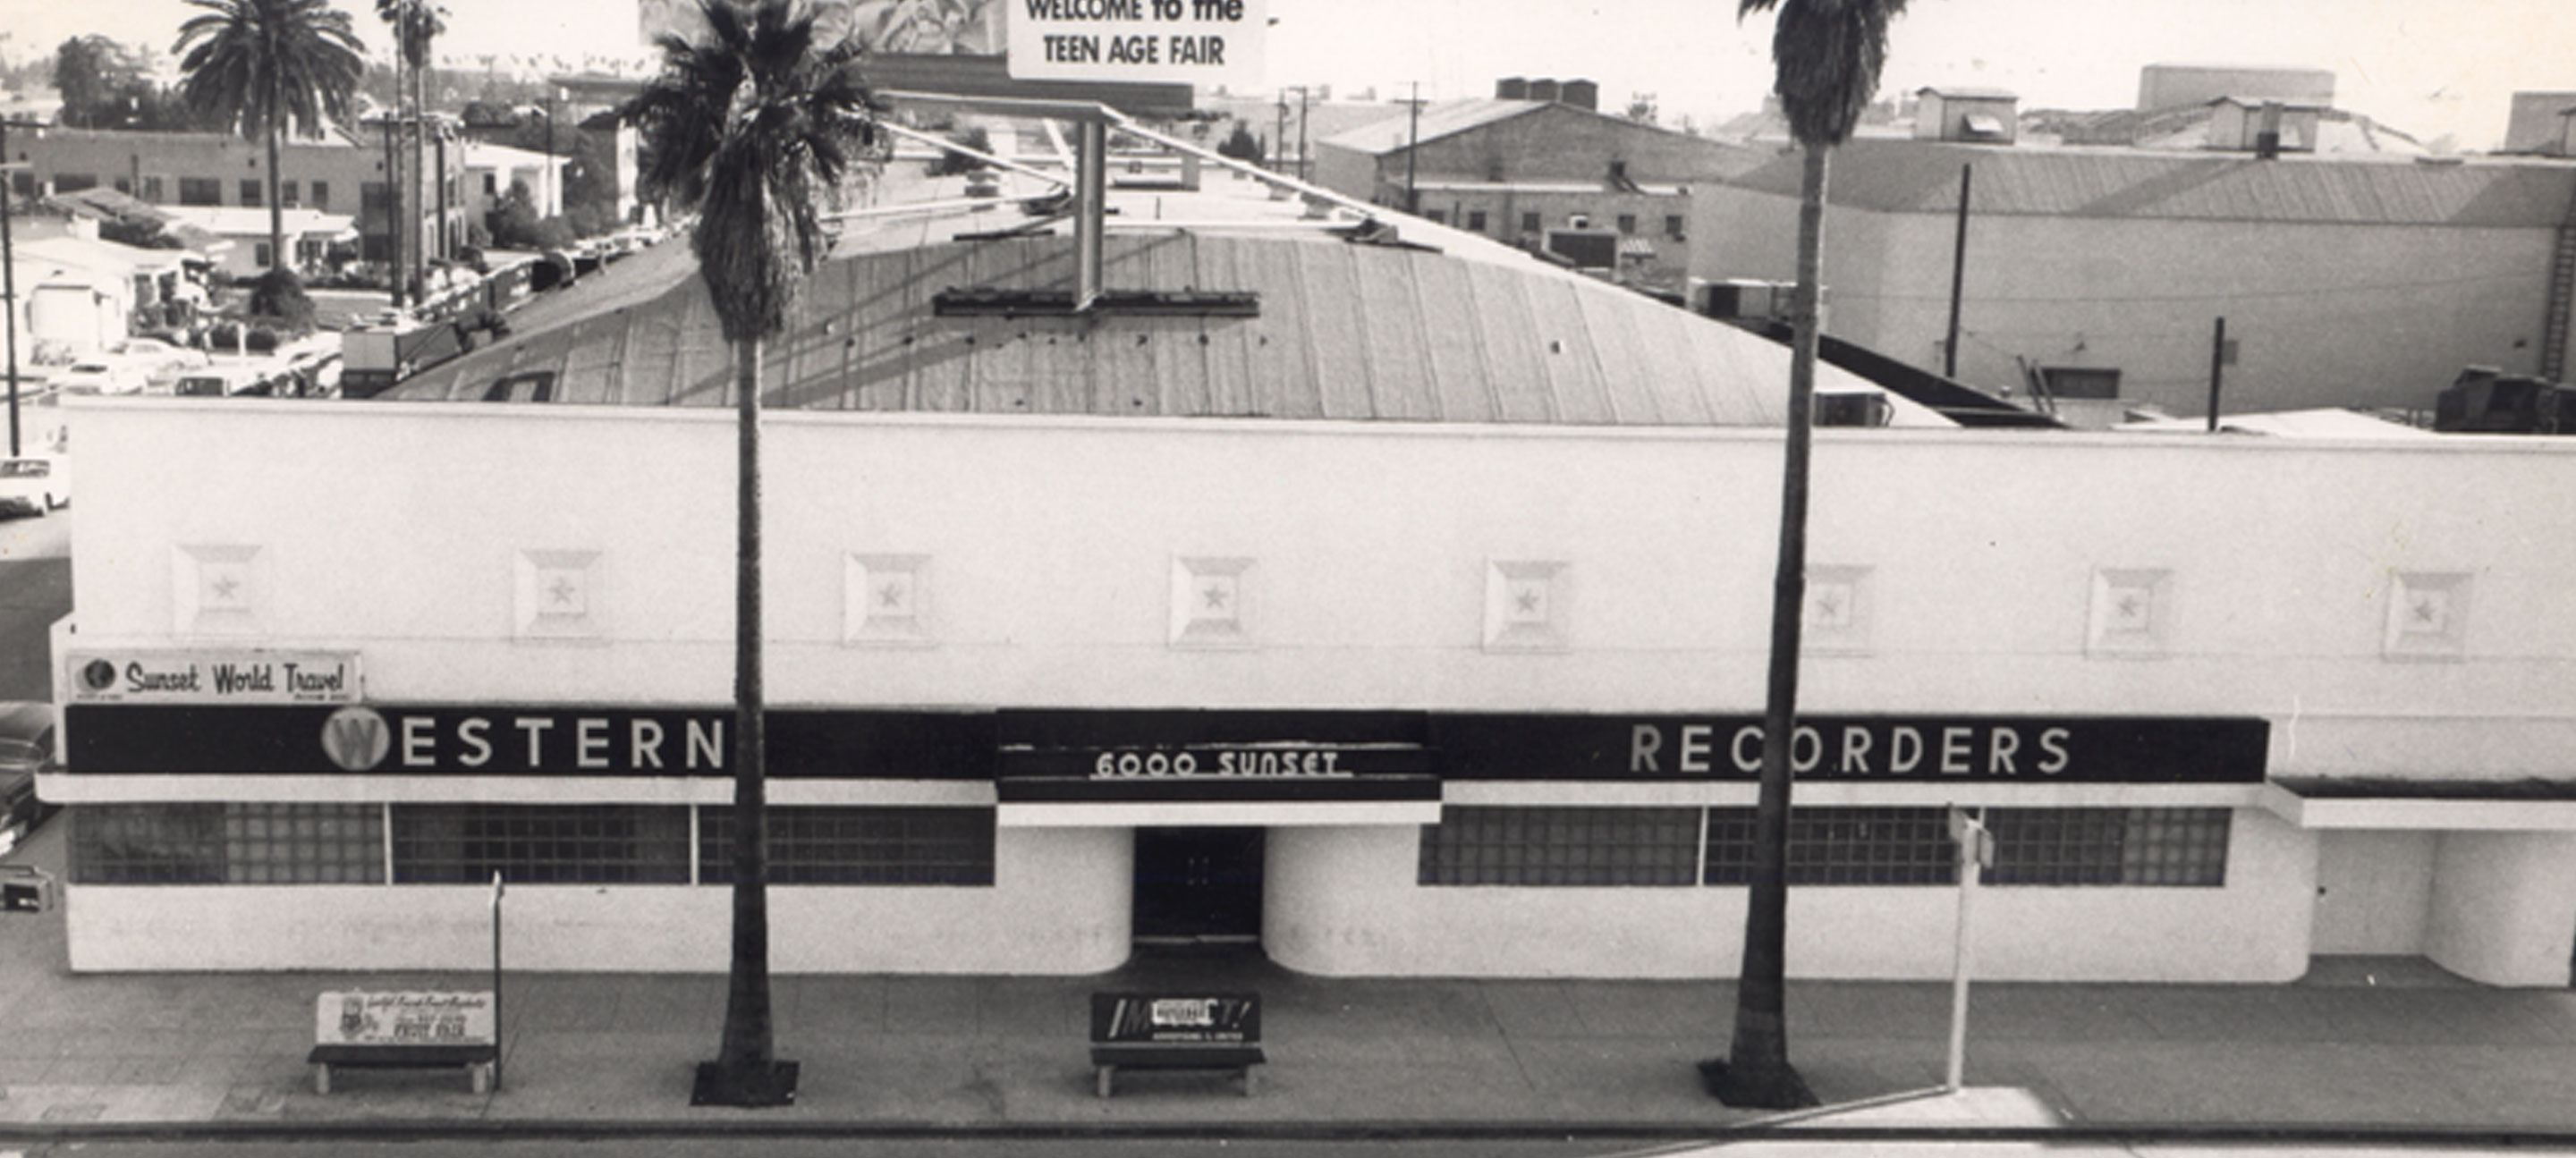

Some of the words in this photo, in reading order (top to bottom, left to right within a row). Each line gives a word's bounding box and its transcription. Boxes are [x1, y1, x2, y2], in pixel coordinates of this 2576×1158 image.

[1027, 0, 1143, 21] WELCOME
[1150, 0, 1183, 21] to
[1192, 0, 1244, 21] the
[1043, 35, 1100, 63] TEEN
[1107, 36, 1159, 64] AGE
[1169, 36, 1225, 65] FAIR
[125, 660, 201, 693] Sunset
[211, 663, 275, 694] World
[283, 662, 344, 693] Travel
[324, 709, 724, 770] WESTERN
[1629, 724, 2071, 775] RECORDERS
[1096, 752, 1197, 778] 6000
[1217, 752, 1339, 778] SUNSET
